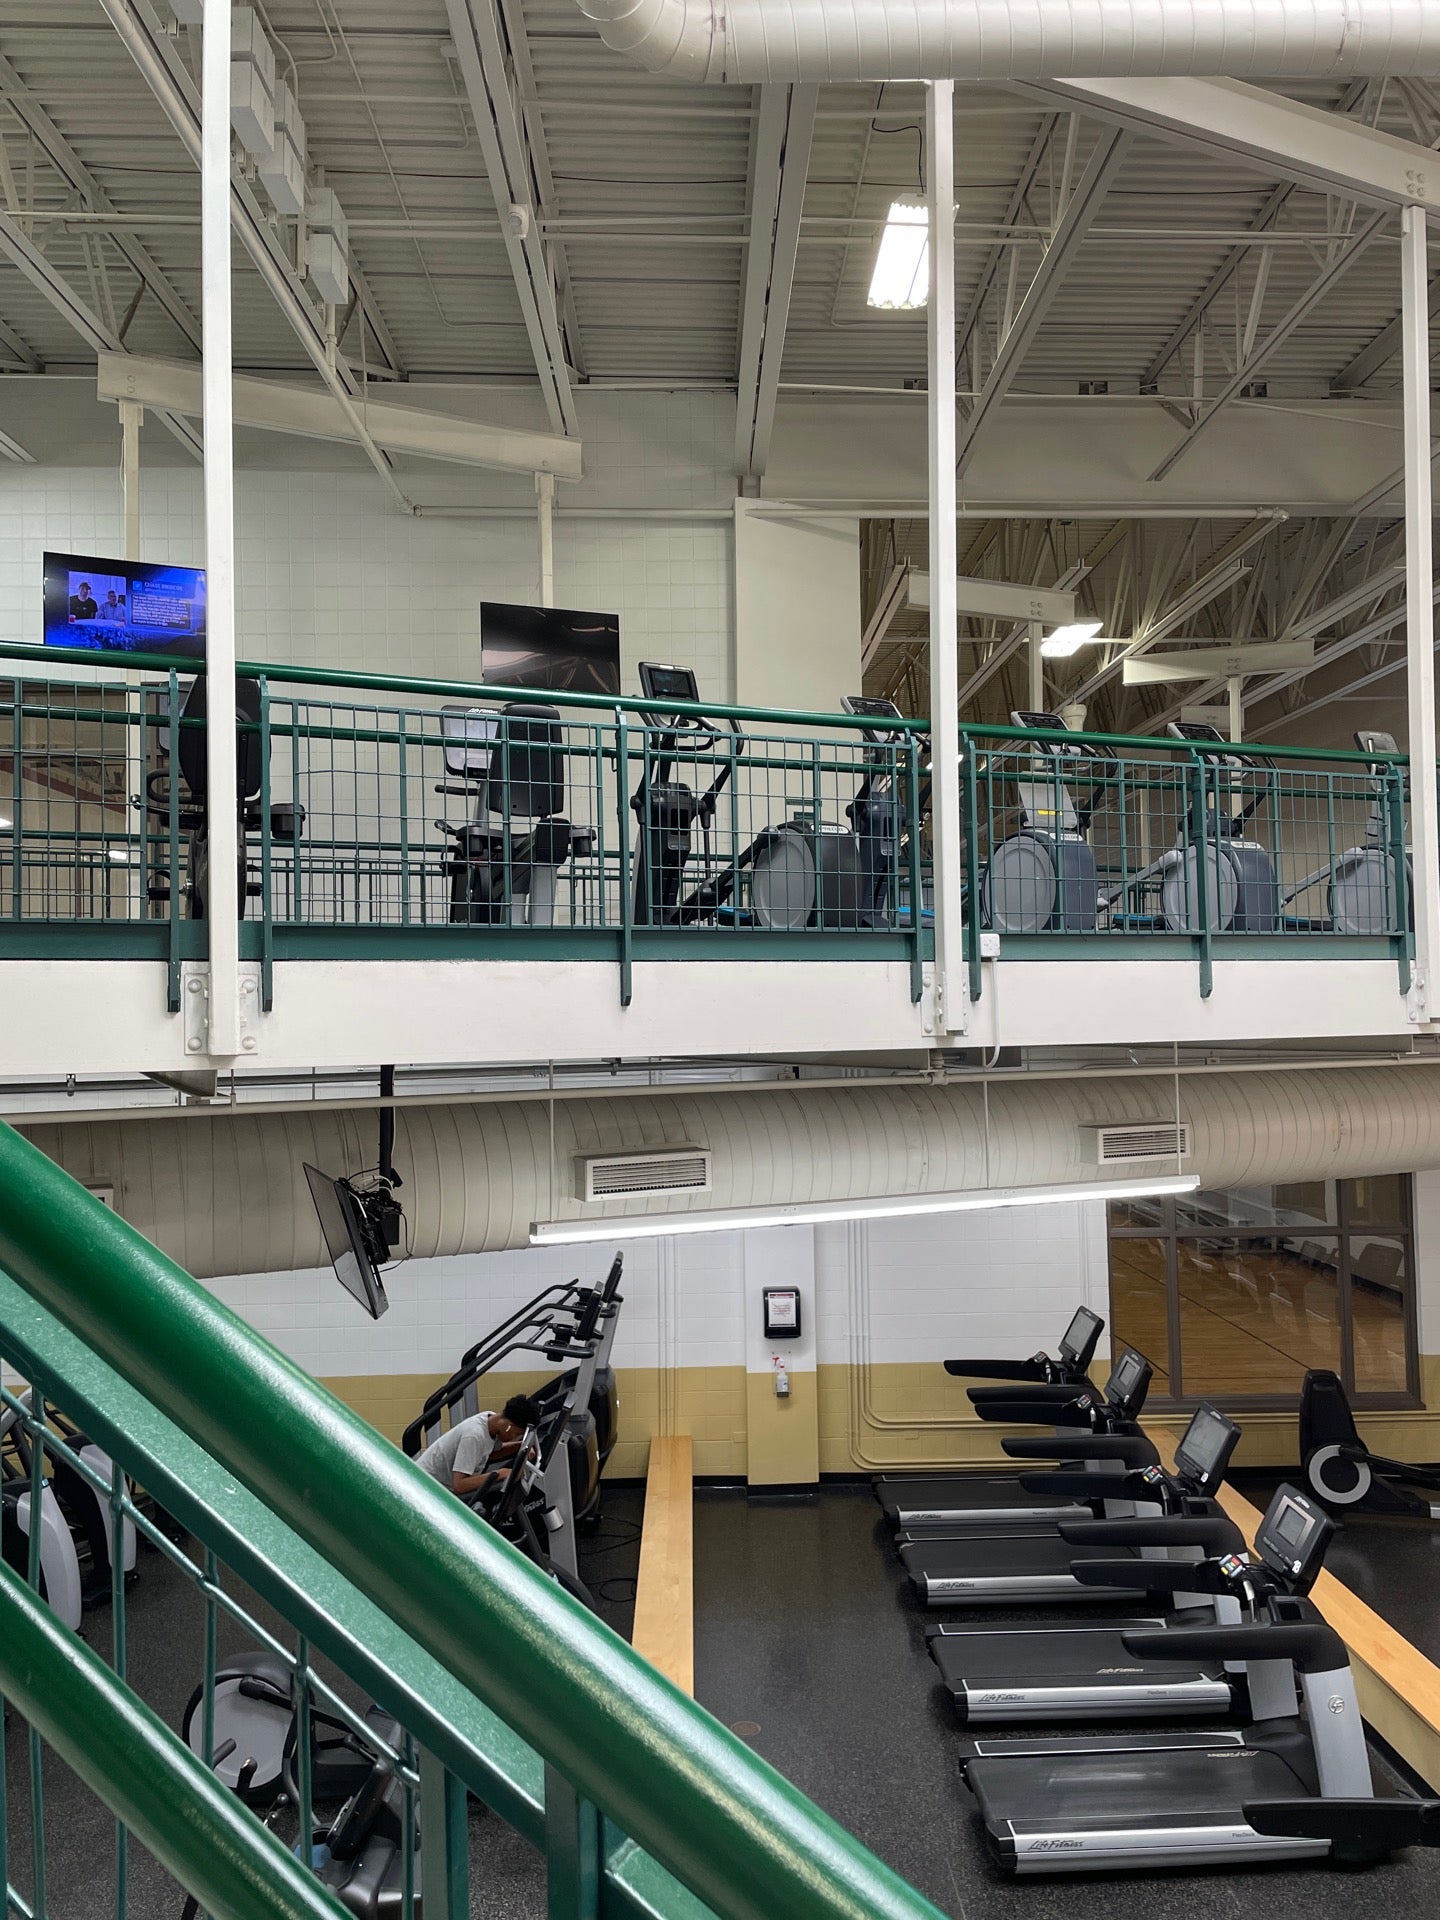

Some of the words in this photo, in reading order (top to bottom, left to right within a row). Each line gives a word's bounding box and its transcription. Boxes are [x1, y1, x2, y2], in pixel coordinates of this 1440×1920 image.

[978, 1693, 997, 1703] Life
[995, 1693, 1026, 1703] Fitness
[1028, 1840, 1049, 1851] Life
[1047, 1840, 1085, 1850] Fitness
